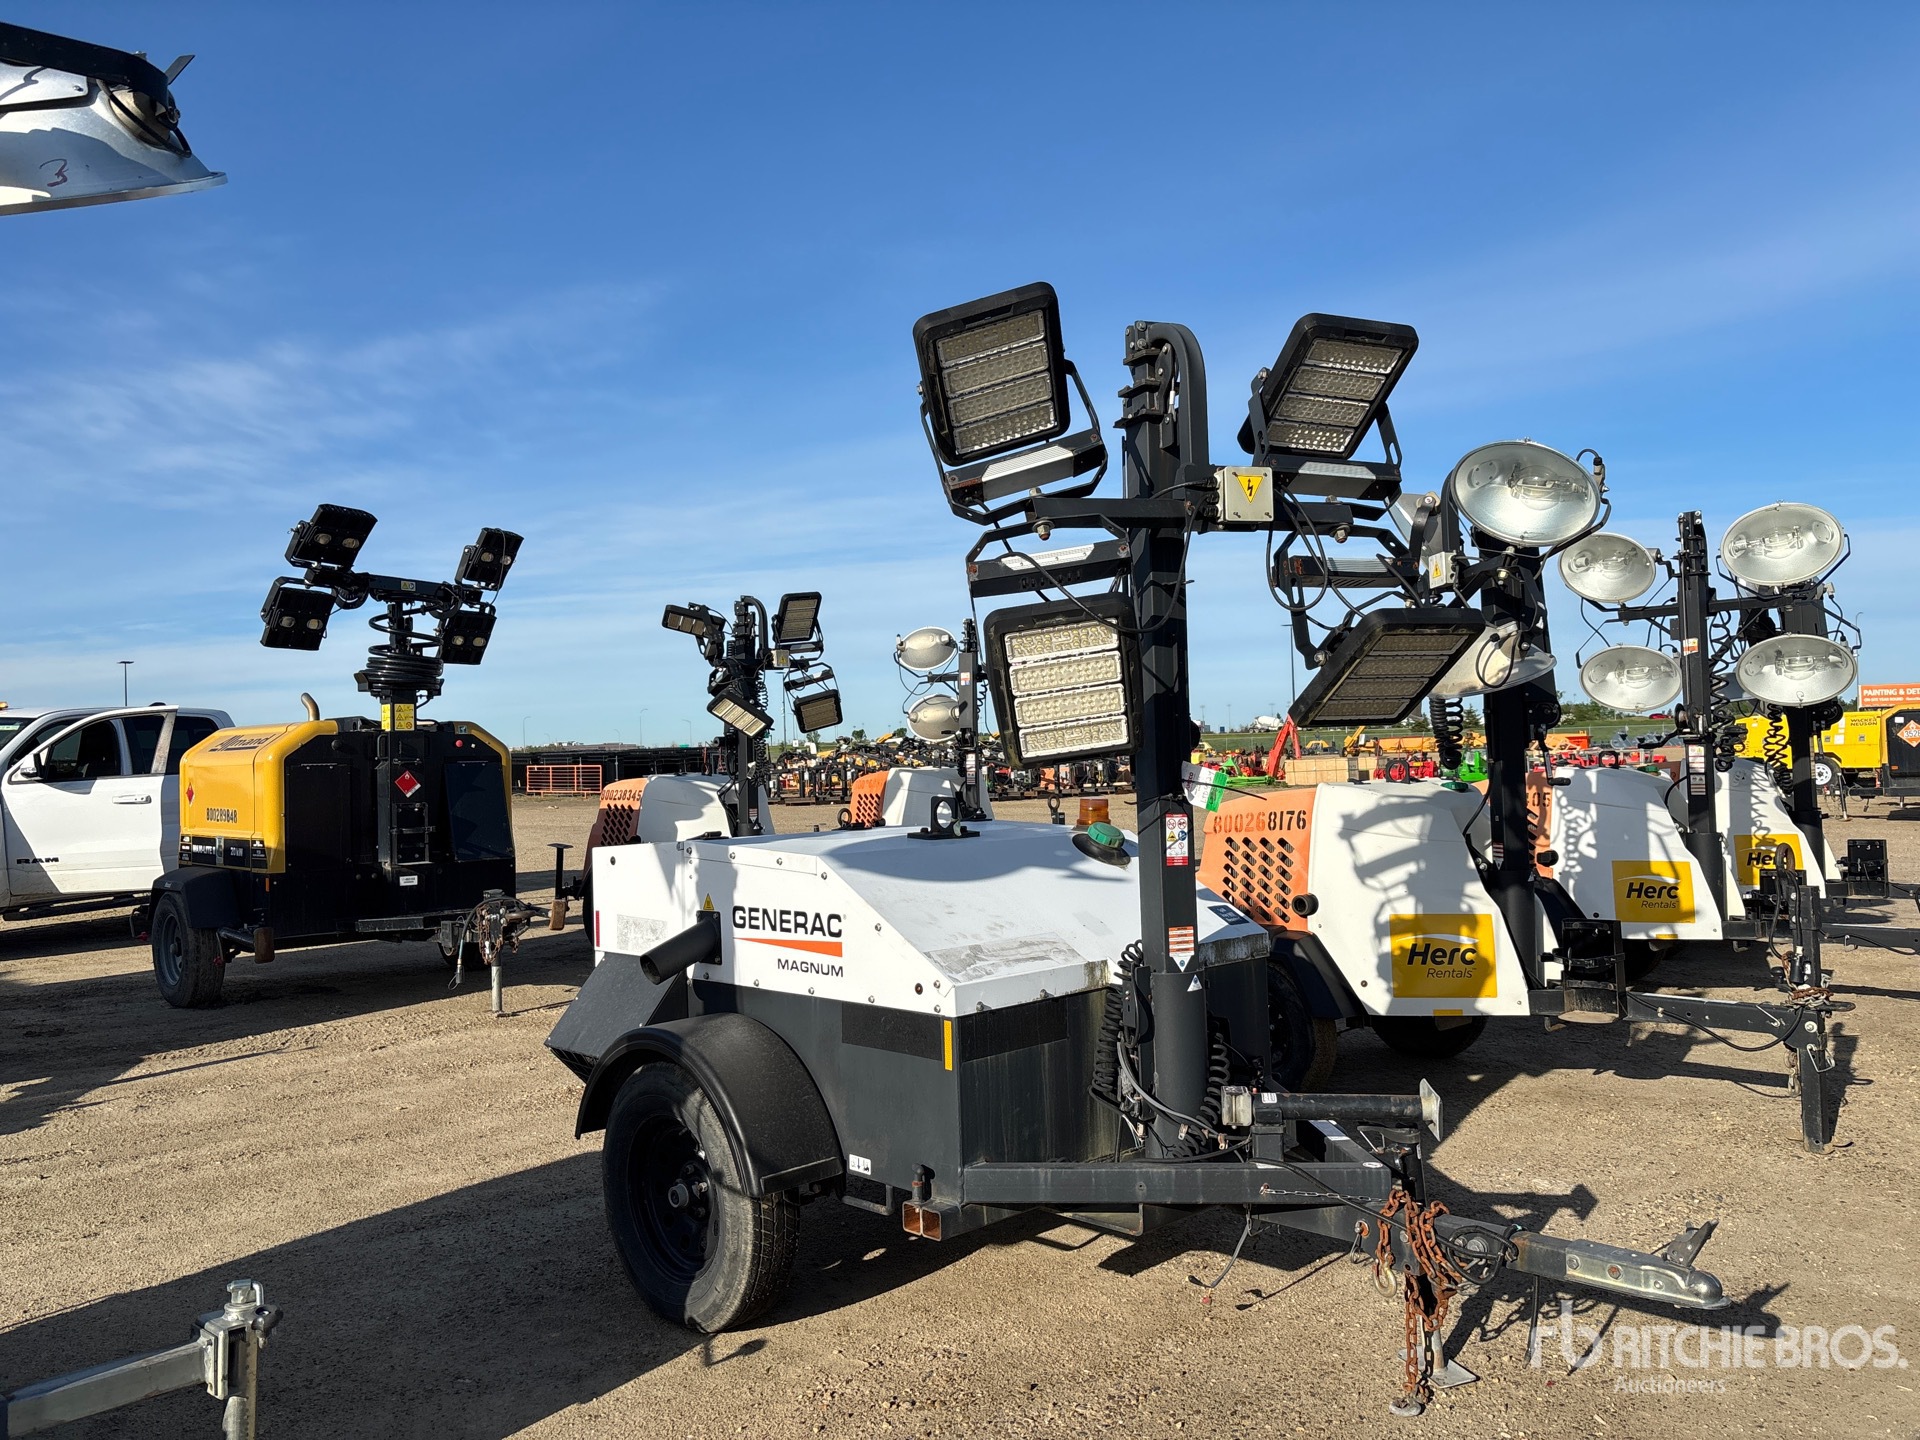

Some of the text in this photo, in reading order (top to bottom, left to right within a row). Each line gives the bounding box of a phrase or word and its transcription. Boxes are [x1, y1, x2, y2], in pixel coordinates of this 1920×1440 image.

[1213, 809, 1307, 834] 800268176
[16, 857, 60, 865] RAM
[1626, 881, 1679, 899] Herc
[1641, 900, 1677, 909] Rentals
[732, 905, 843, 938] GENERAC
[1407, 942, 1477, 966] Herc
[777, 958, 844, 978] MAGNUM
[1426, 967, 1473, 979] Rentals
